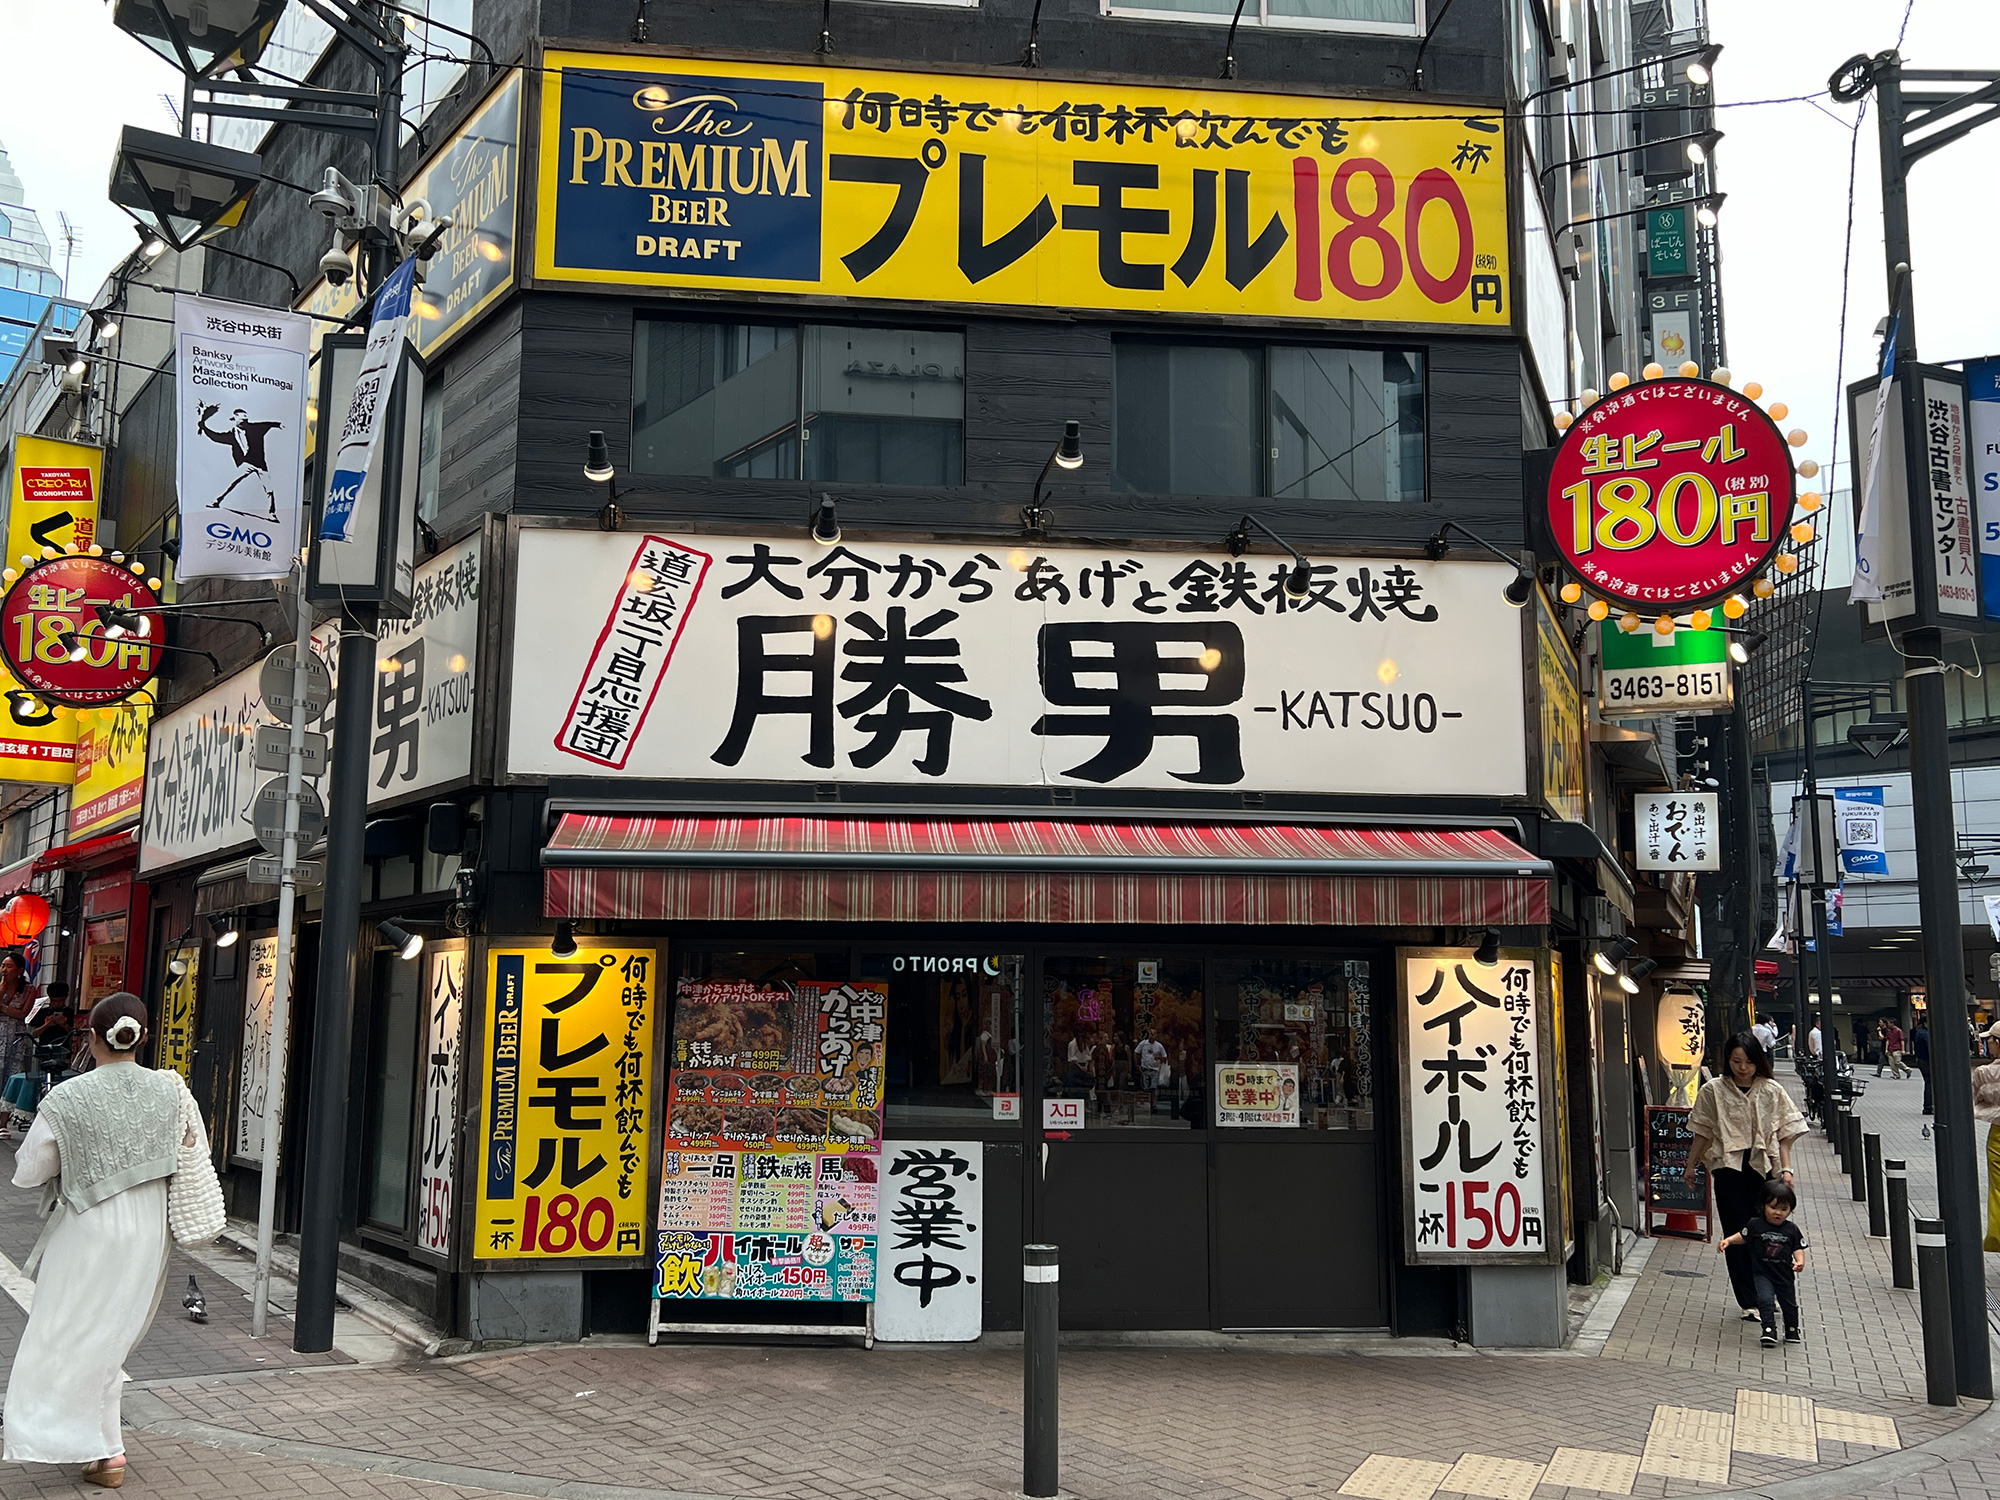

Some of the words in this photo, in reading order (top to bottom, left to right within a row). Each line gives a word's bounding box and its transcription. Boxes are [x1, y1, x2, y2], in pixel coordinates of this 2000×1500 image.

[633, 87, 753, 137] The
[568, 127, 812, 197] PREMIUM
[648, 193, 732, 228] BEER
[828, 137, 1290, 293] プレモル
[451, 233, 480, 281] BEER
[635, 235, 742, 262] DRAFT
[1654, 249, 1682, 261] そいる
[445, 268, 482, 315] DRAFT
[206, 316, 282, 340] 渋谷中央街
[192, 345, 233, 363] Banksy
[192, 355, 235, 371] Artworks
[235, 362, 256, 373] from
[192, 365, 250, 381] Masatoshi
[250, 373, 294, 391] Kumagai
[192, 374, 248, 391] Collection
[1579, 422, 1746, 475] 生ビール
[1928, 398, 1956, 577] 渋谷古書センター
[1561, 471, 1770, 555] 180円
[205, 522, 272, 550] GMO
[206, 539, 272, 562] デジタル美術館
[1954, 496, 1974, 577] 古書買入
[13, 612, 151, 671] 180円
[709, 606, 1246, 786] 勝男
[1609, 671, 1723, 701] 3463-8151
[372, 636, 426, 790] 男
[1648, 802, 1661, 860] あご出汁一番
[1664, 800, 1691, 863] おでん
[1693, 801, 1707, 861] 鶏出汁一番
[1850, 853, 1879, 863] GMO
[505, 973, 516, 1007] DRAFT
[858, 988, 885, 1004] 大分
[496, 1007, 519, 1061] BEER
[820, 984, 861, 1078] からあげ
[850, 1001, 883, 1042] 中津
[425, 956, 457, 1170] ハイボール
[688, 1053, 738, 1068] からあげ
[751, 1060, 780, 1071] 680円
[752, 1050, 780, 1061] 499円
[1414, 963, 1503, 1174] ハイボール
[520, 953, 617, 1190] プレモル
[613, 953, 650, 1200] 何時でも何杯飲んでも
[1225, 1072, 1274, 1086] 朝5時まで
[1500, 966, 1537, 1180] 何時でも何杯飲んでも
[492, 1063, 517, 1142] PREMIUM
[1049, 1103, 1078, 1118] 入口
[1224, 1088, 1275, 1105] 営業中
[690, 1140, 712, 1148] 499円
[743, 1141, 766, 1149] 450円
[796, 1143, 818, 1151] 499円
[686, 1154, 736, 1179] 一品
[756, 1155, 812, 1180] 鉄板焼
[818, 1157, 842, 1181] 馬
[833, 1211, 877, 1222] だし巻き卵
[704, 1234, 803, 1267] ハイボール
[840, 1237, 875, 1251] サワー
[661, 1254, 702, 1294] 飲
[736, 1264, 763, 1275] トリス
[736, 1274, 783, 1285] ハイボール
[782, 1267, 826, 1285] 150円
[734, 1288, 778, 1298] 角ハイボール
[779, 1289, 803, 1298] 220円
